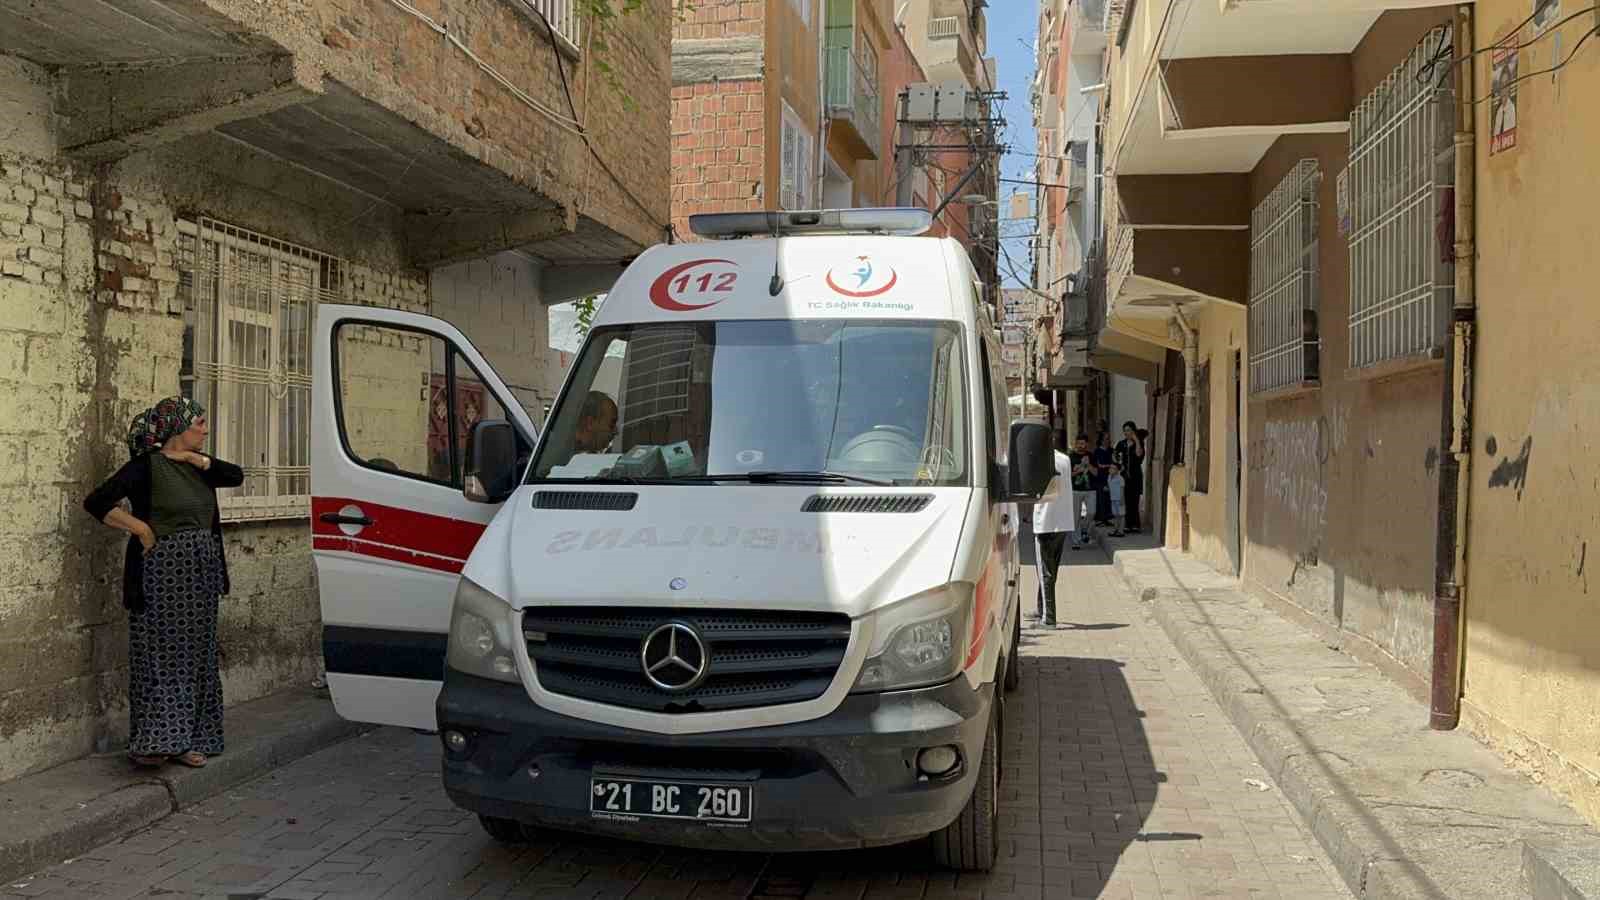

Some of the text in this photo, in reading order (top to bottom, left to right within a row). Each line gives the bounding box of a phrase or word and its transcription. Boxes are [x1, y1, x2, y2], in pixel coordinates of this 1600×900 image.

[674, 272, 737, 293] 112
[606, 783, 741, 816] 21 BC 260
